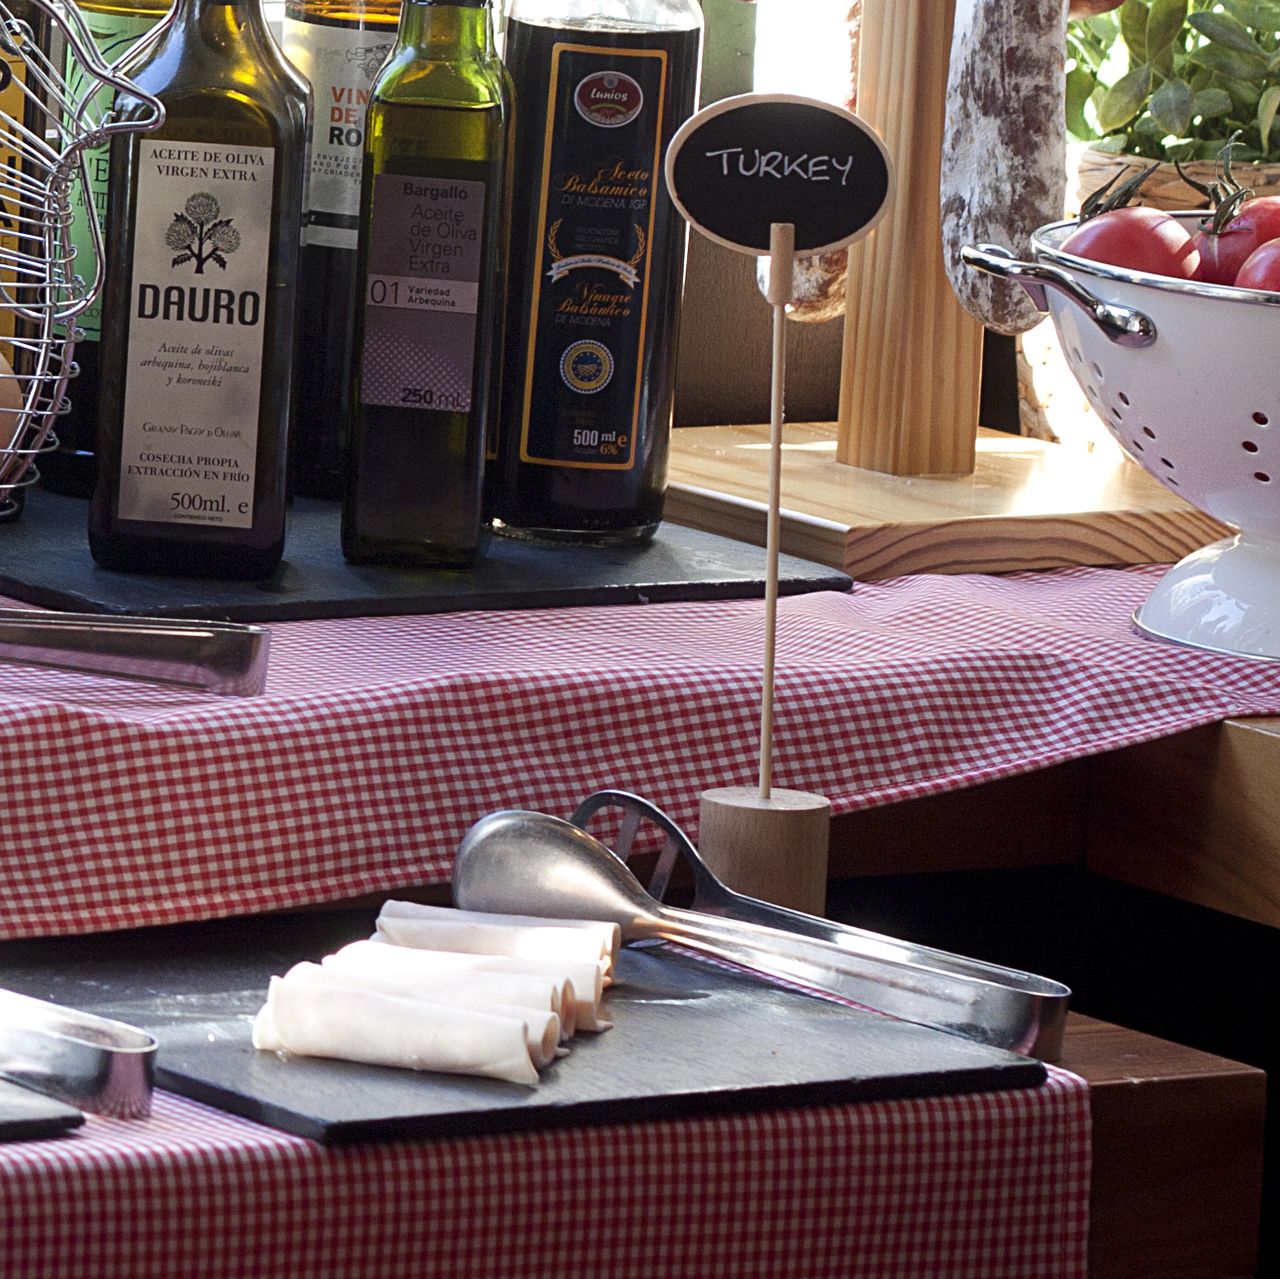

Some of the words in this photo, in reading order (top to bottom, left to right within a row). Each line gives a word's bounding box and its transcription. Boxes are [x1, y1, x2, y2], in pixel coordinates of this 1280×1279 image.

[591, 88, 628, 102] Lunios
[149, 148, 199, 162] ACEITE
[203, 152, 222, 163] DE
[225, 153, 265, 166] OLIVA
[156, 164, 209, 179] VIRGEN
[212, 169, 257, 182] EXTRA
[705, 147, 854, 186] TURKEY
[403, 182, 468, 201] Bargalló
[411, 204, 464, 223] Aceite
[410, 223, 431, 238] de
[437, 222, 477, 241] Oliva
[409, 238, 463, 258] Virgen
[409, 255, 450, 273] Extra
[370, 280, 399, 304] 01
[408, 285, 450, 297] Variedad
[138, 283, 260, 326] DAURO
[407, 296, 456, 307] Arbequina
[190, 344, 201, 355] de
[204, 345, 234, 358] olivas
[401, 387, 433, 404] 250
[573, 428, 599, 446] 500
[601, 431, 616, 442] ml
[139, 452, 193, 465] COSECHA
[197, 455, 239, 468] PROPIA
[127, 465, 200, 480] EXTRACCIÓN
[204, 470, 219, 481] EN
